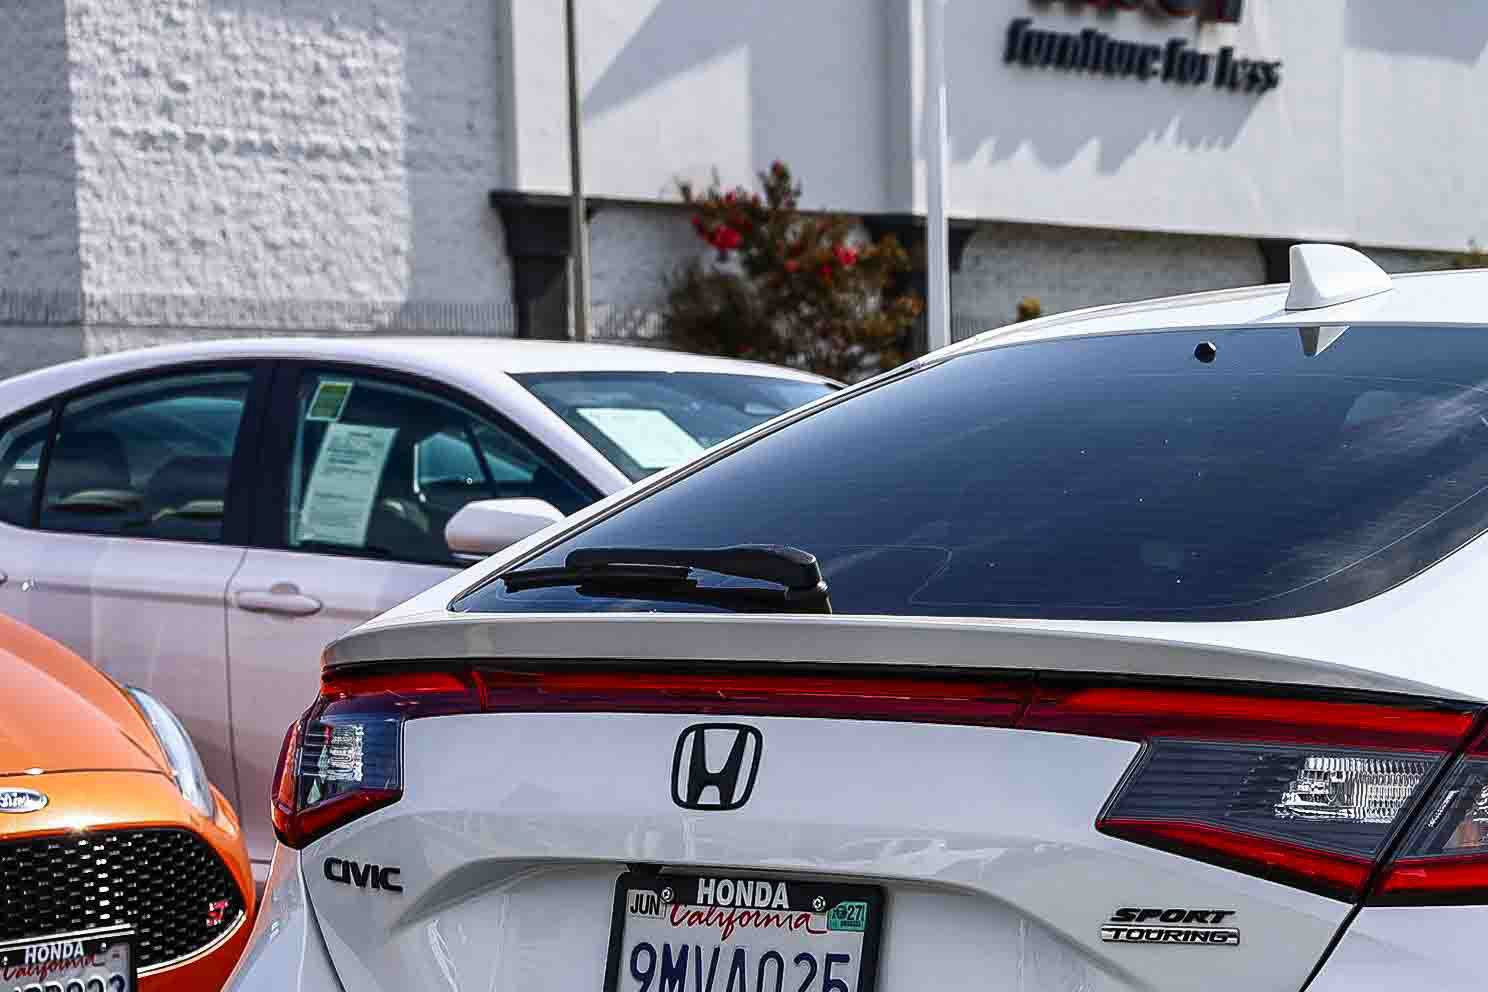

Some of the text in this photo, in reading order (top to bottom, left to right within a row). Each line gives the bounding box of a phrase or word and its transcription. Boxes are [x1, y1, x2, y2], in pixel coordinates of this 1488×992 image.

[323, 857, 403, 892] CIVIC
[630, 893, 661, 916] JUN
[697, 878, 789, 909] HONDA
[669, 902, 828, 941] California
[847, 904, 863, 921] 27
[1110, 908, 1236, 923] SPORT
[1101, 927, 1235, 943] TOURING
[25, 941, 84, 964] HONDA
